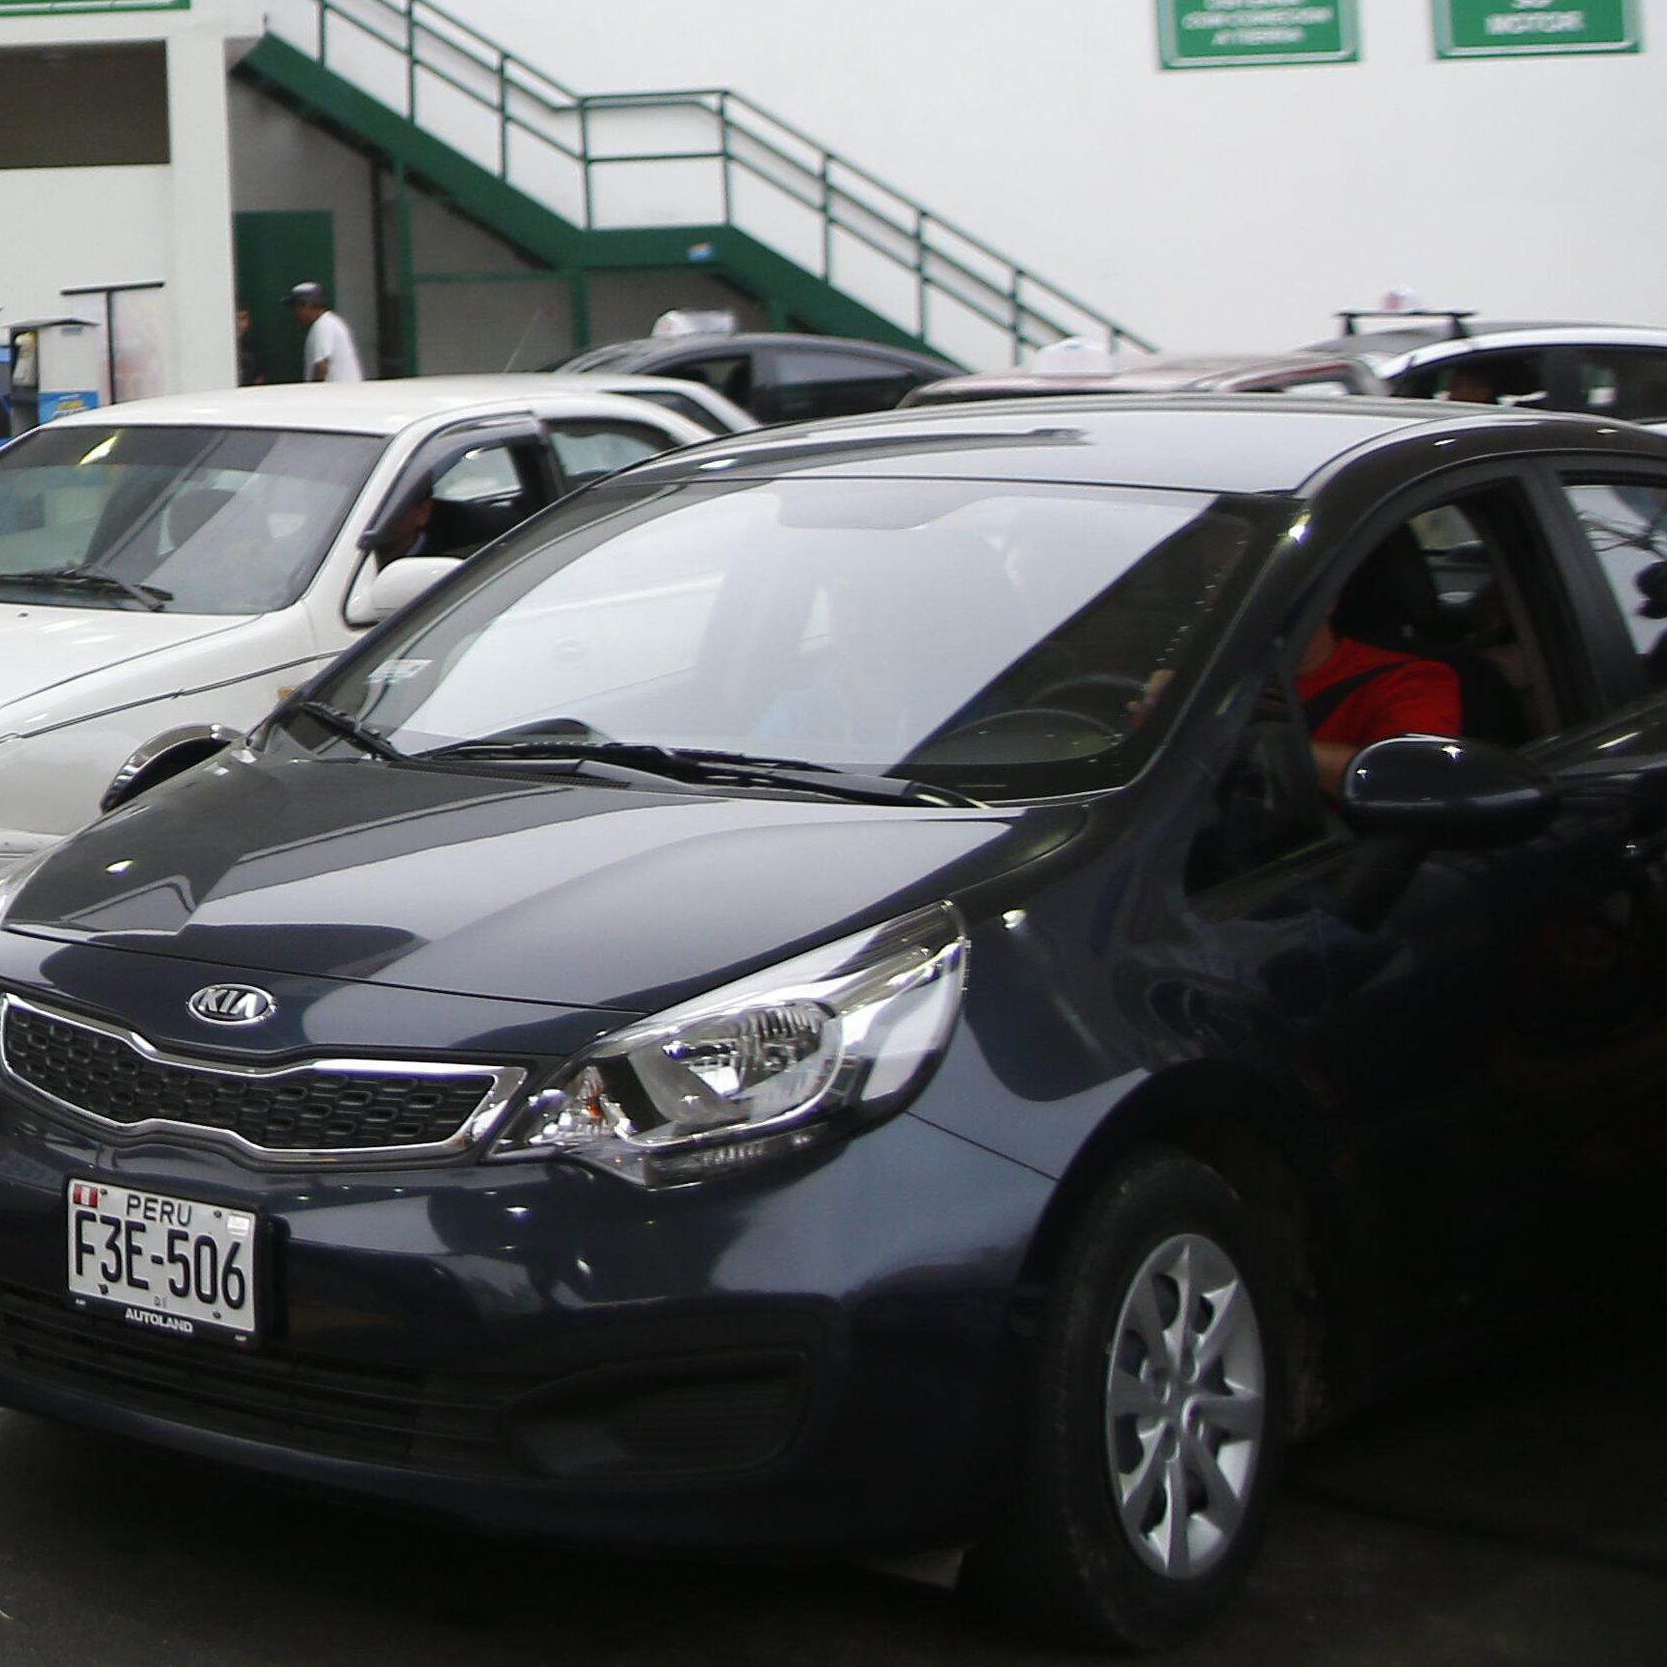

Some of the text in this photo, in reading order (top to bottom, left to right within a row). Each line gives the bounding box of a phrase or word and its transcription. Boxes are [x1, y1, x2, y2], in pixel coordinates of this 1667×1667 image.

[199, 988, 257, 1019] KIA
[126, 1194, 191, 1226] PERU
[75, 1210, 245, 1310] F3E-506
[125, 1308, 193, 1333] AUTOLAND
